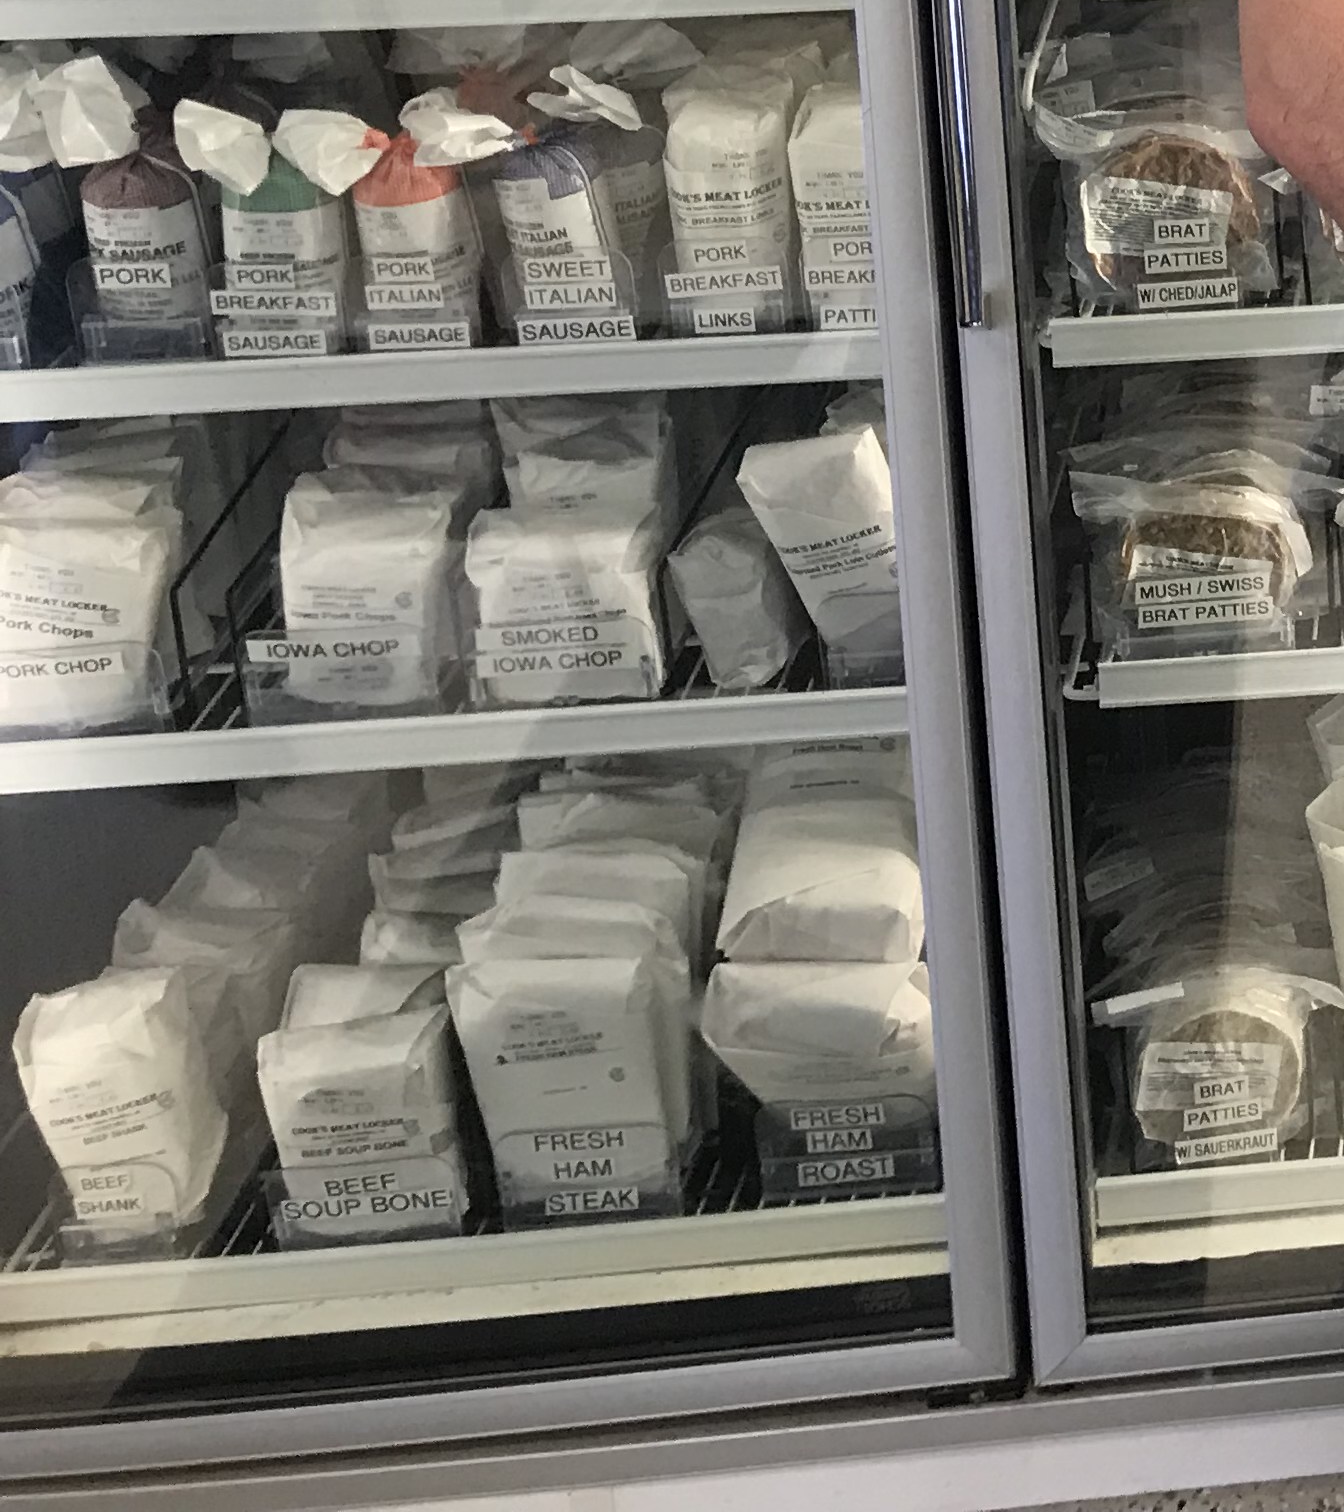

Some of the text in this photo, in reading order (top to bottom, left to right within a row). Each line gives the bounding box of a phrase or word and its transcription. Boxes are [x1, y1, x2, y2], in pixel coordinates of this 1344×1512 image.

[1158, 224, 1206, 238] BRAT
[694, 244, 746, 263] PORK
[834, 241, 872, 256] POR
[1148, 250, 1224, 268] PATTIES
[100, 268, 167, 285] PORK
[238, 270, 292, 284] PORK
[377, 262, 431, 278] PORK
[528, 261, 607, 278] SWEET
[670, 270, 778, 292] BREAKFAST
[370, 288, 441, 305] ITALIAN
[529, 287, 614, 305] ITALIAN
[1159, 283, 1236, 302] CHED/JALAP
[215, 296, 332, 312] BREAKFAST
[698, 312, 752, 328] LINKS
[824, 309, 876, 324] PATTI
[375, 327, 466, 345] SAUSAGE
[523, 320, 632, 342] SAUSAGE
[228, 335, 320, 352] SAUSAGE
[1140, 582, 1191, 600] MUSH
[1206, 576, 1264, 594] SWISS
[1142, 600, 1270, 624] BRAT PATTIES
[502, 628, 598, 646] SMOKED
[266, 640, 400, 658] IOWA CHOP
[54, 657, 112, 675] CHOP
[493, 650, 622, 674] IOWA CHOP
[1200, 1080, 1246, 1099] BRAT
[794, 1106, 881, 1128] FRESH
[1188, 1103, 1259, 1126] PATTIES
[534, 1131, 624, 1152] FRESH
[810, 1132, 868, 1150] HAM
[1194, 1133, 1274, 1157] SAUERKRAUT
[554, 1160, 612, 1180] HAM
[803, 1158, 891, 1180] ROAST
[80, 1174, 128, 1191] BEEF
[324, 1172, 396, 1196] BEEF
[78, 1198, 140, 1214] SHANK
[284, 1198, 361, 1220] SOUP
[548, 1190, 638, 1212] STEAK
